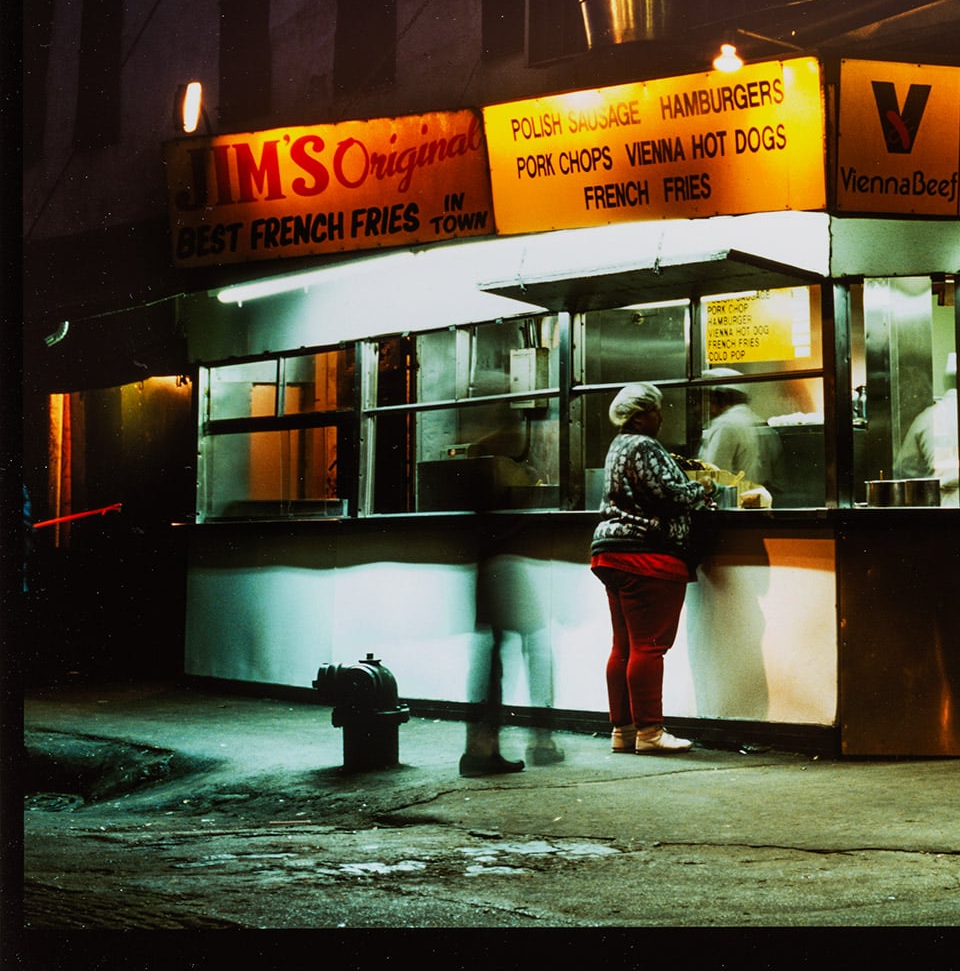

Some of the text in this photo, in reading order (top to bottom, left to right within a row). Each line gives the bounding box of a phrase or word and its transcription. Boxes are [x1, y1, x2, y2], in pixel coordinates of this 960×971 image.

[511, 79, 784, 141] POLISH SAUSAGE HAMBURGERS
[517, 124, 787, 179] PORK CHOPS VIENNA HOT DOGS
[176, 115, 482, 211] JIM'S Original
[445, 193, 465, 211] IN
[584, 173, 711, 210] FRENCH FRIES
[177, 202, 419, 260] BEST FRENCH FRIES
[430, 211, 488, 236] TOWN
[707, 303, 748, 315] PORK CHOP
[707, 315, 752, 326] HAMBURGER
[708, 325, 769, 338] VIENNA HOT DOG
[708, 337, 760, 349] FRENCH FRIES
[709, 350, 745, 361] COLD POP
